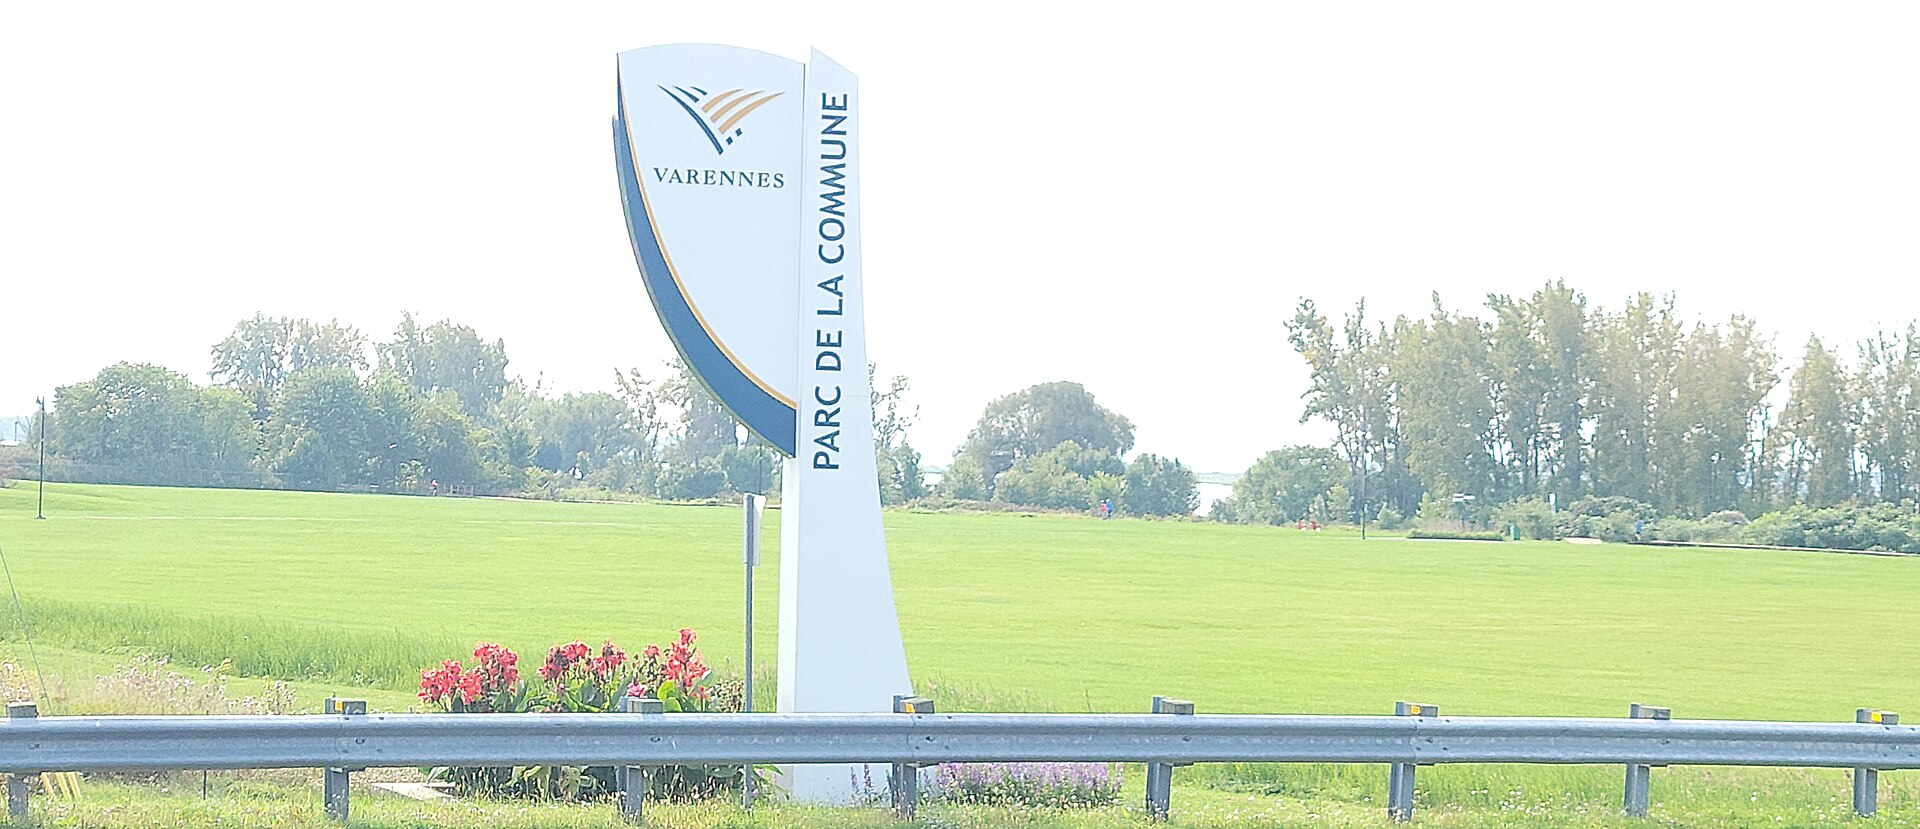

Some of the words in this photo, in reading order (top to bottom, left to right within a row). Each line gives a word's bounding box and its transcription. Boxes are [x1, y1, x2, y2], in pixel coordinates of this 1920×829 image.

[653, 167, 784, 189] VARENNES
[818, 92, 848, 265] COMMUNE
[816, 274, 844, 316] LA
[816, 329, 843, 372] DE
[813, 386, 842, 470] PARC
